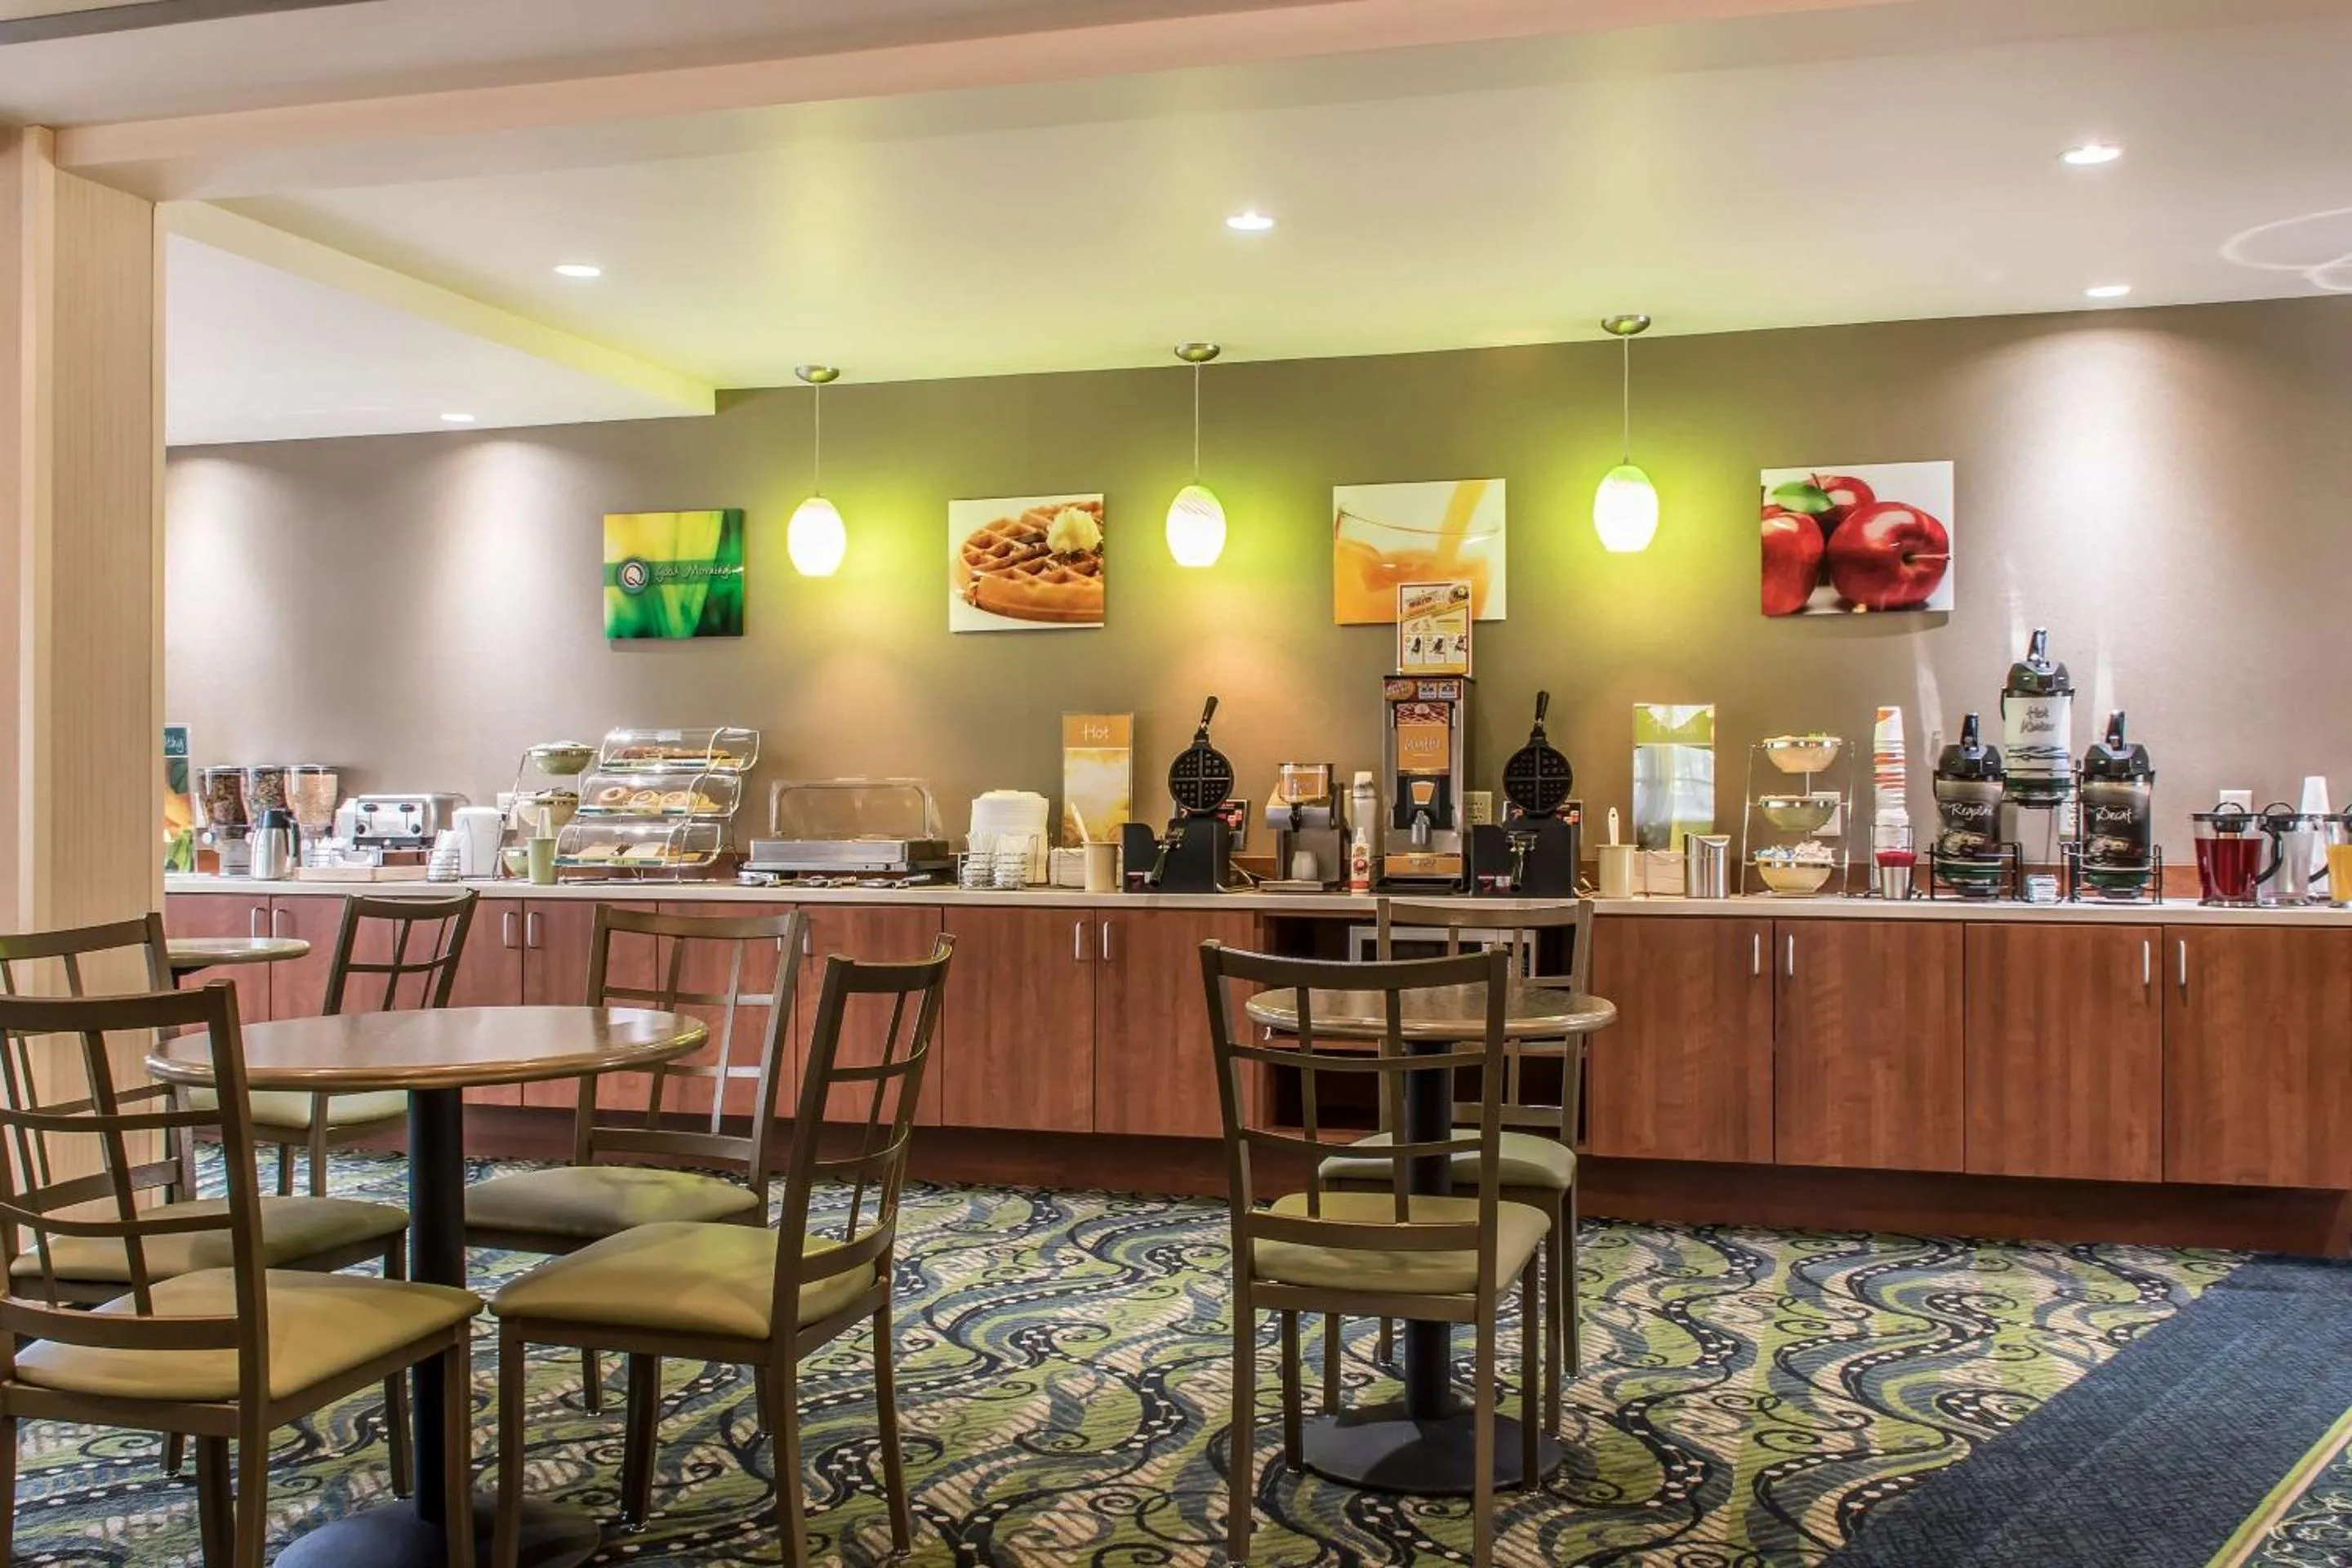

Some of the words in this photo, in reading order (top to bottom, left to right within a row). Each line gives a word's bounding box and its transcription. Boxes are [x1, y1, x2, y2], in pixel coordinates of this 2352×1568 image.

[2025, 705, 2049, 720] Hot
[1080, 724, 1110, 742] Hot
[2096, 805, 2132, 823] Decaf
